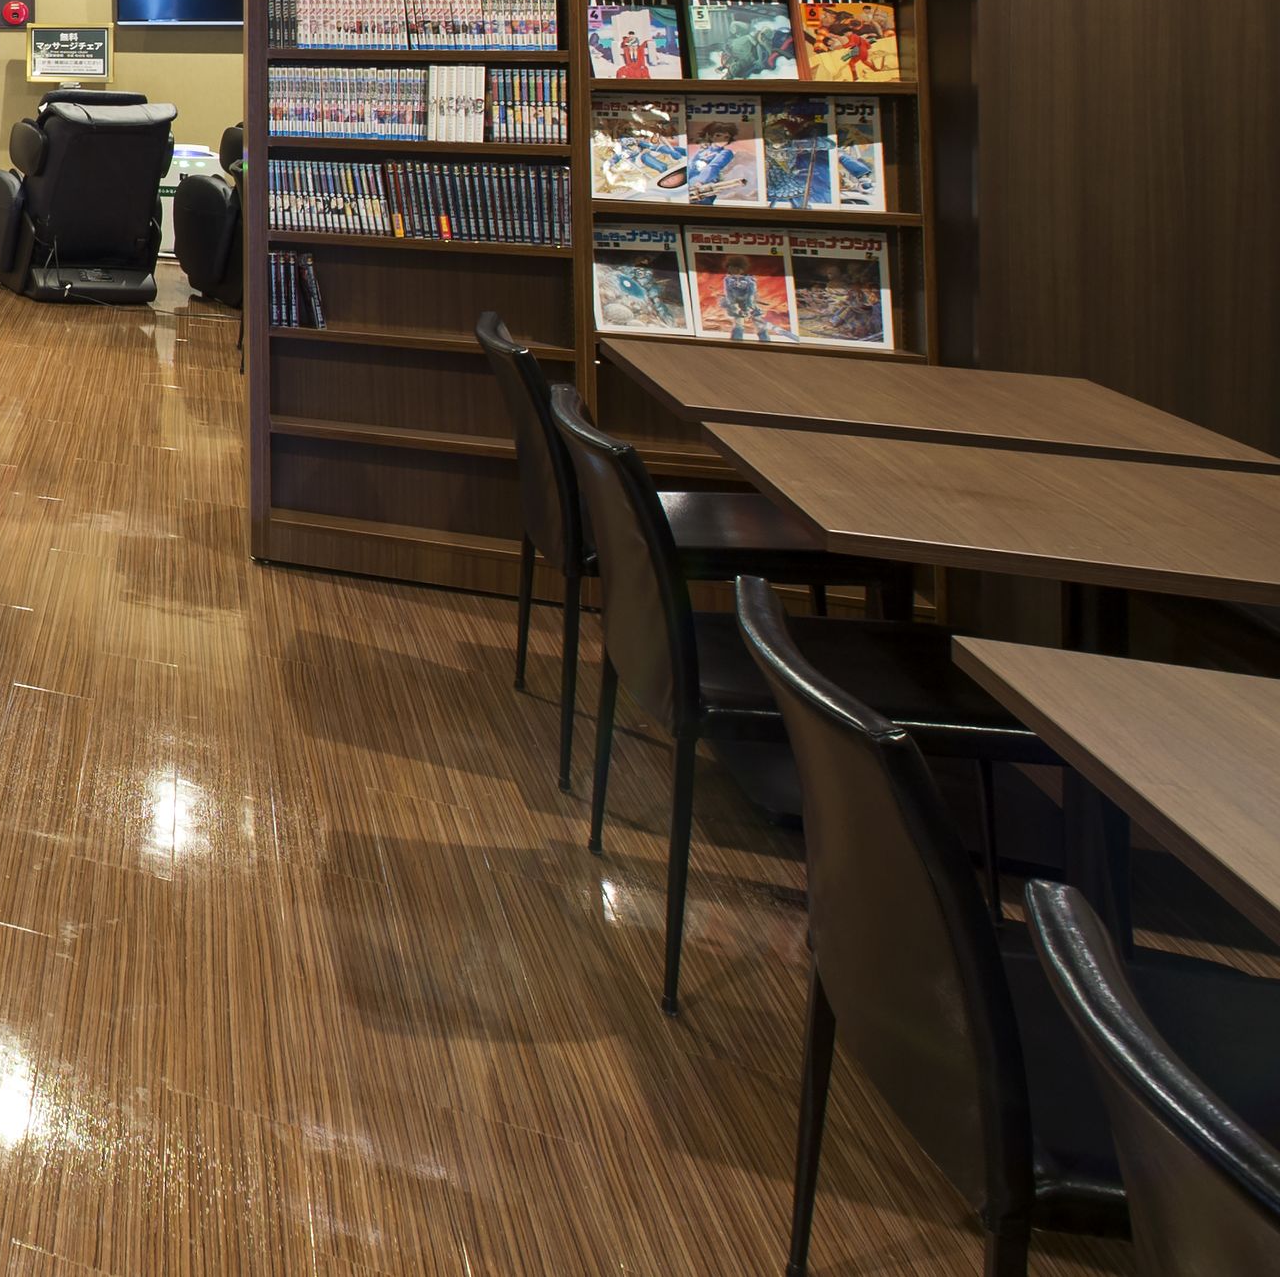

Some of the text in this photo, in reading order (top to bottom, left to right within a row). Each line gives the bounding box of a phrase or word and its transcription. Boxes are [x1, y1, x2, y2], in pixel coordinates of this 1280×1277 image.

[590, 10, 599, 21] 4
[696, 10, 704, 19] 5
[809, 8, 817, 17] 6
[60, 33, 78, 41] 無料
[36, 42, 103, 50] マッサージチェア
